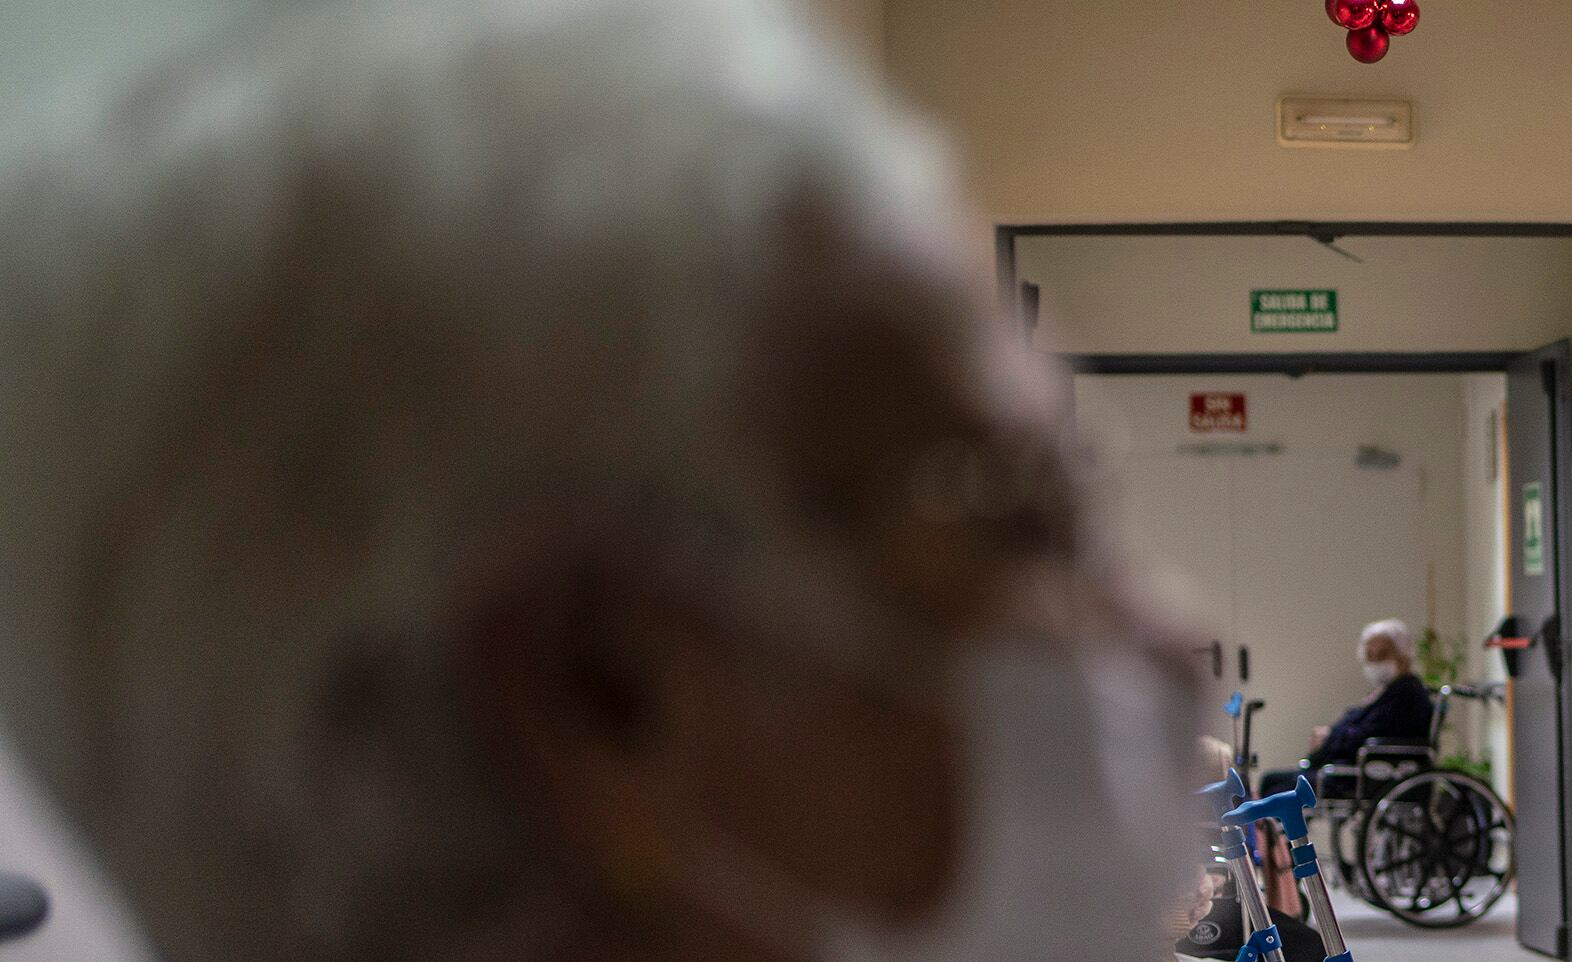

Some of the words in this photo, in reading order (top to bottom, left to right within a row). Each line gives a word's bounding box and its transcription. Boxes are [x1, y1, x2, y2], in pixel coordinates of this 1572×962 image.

[1260, 294, 1306, 310] SALIDA
[1310, 294, 1328, 310] DE
[1255, 312, 1334, 328] EMERGENCIA
